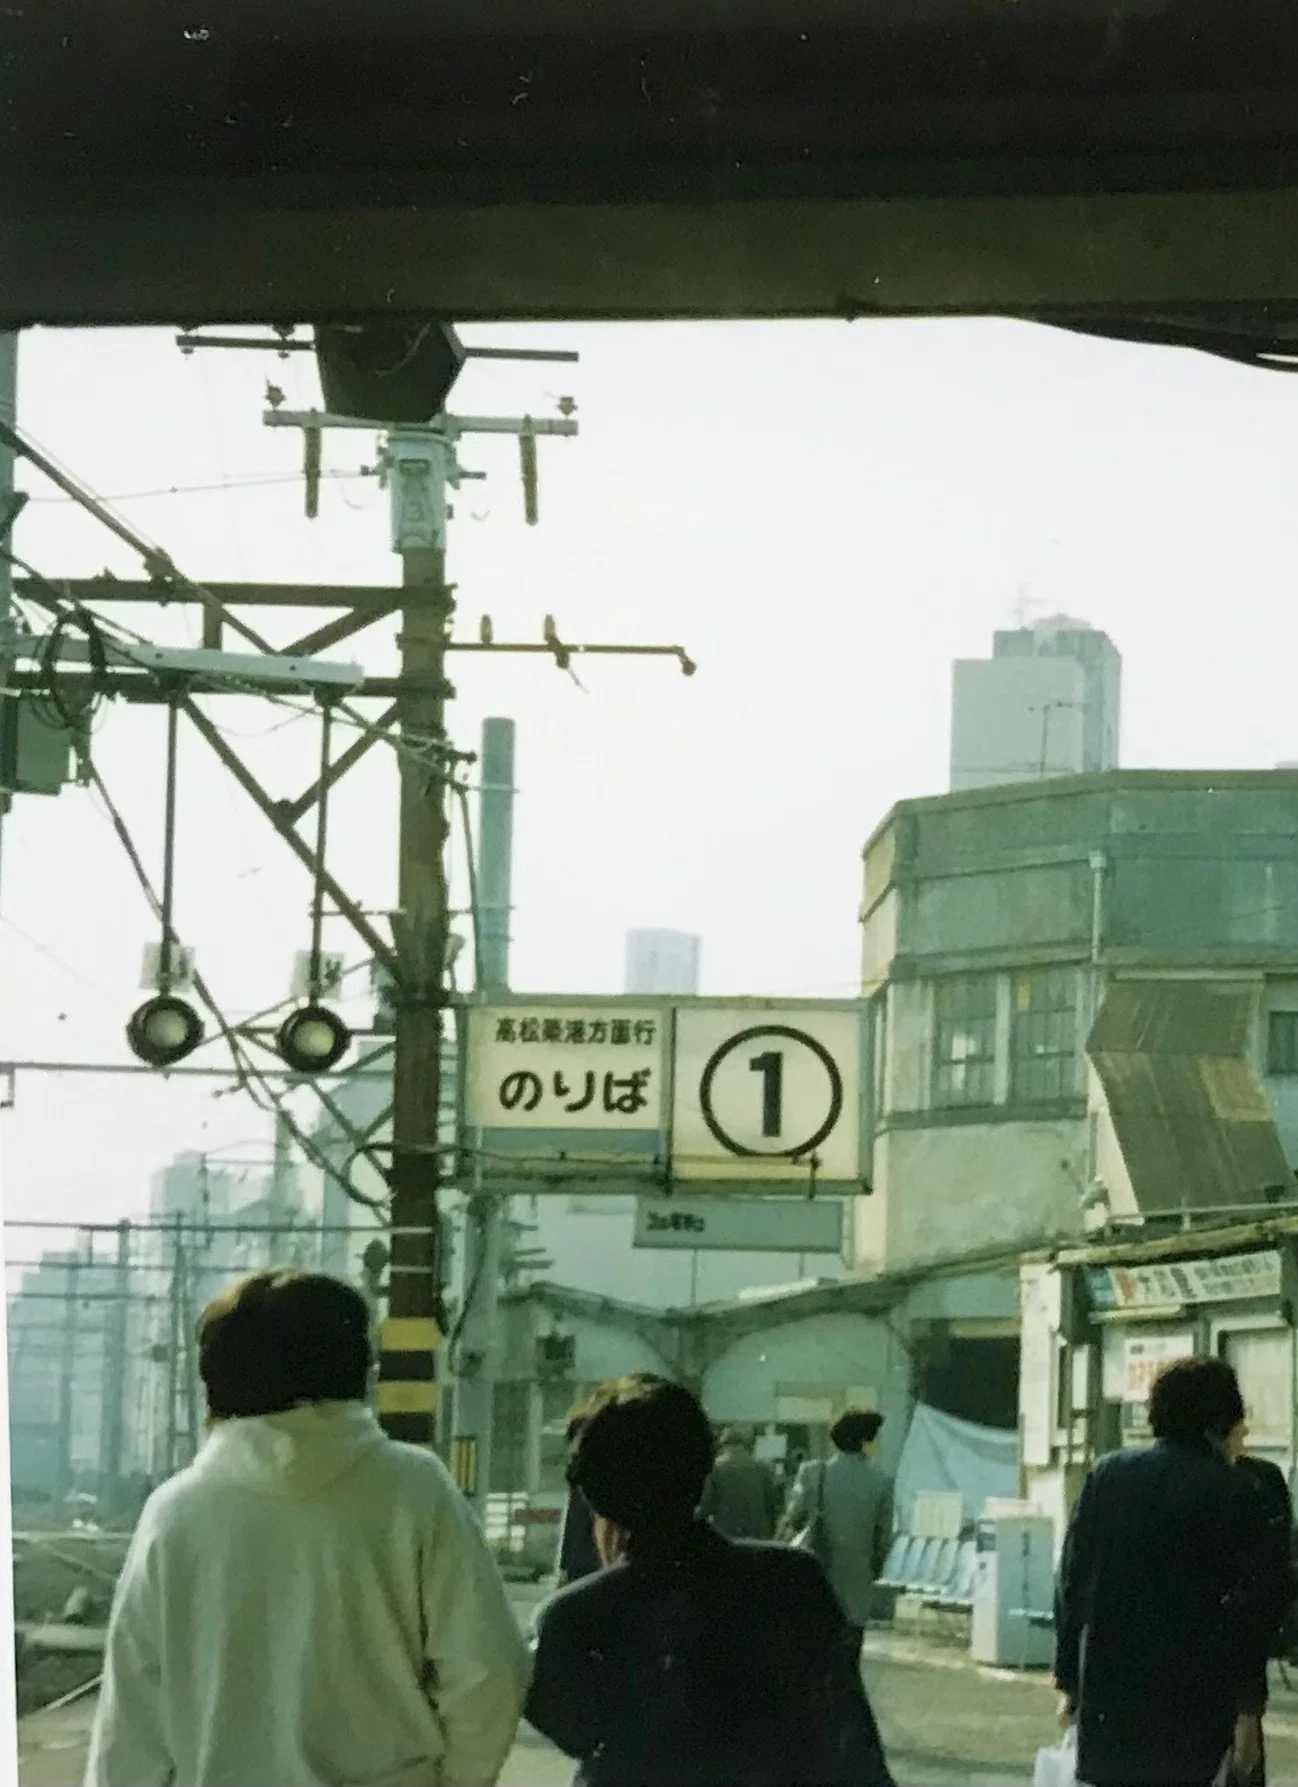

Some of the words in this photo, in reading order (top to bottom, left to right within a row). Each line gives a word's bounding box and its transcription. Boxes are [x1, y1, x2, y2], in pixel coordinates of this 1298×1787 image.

[499, 1069, 651, 1113] のりば
[748, 1051, 784, 1137] 1
